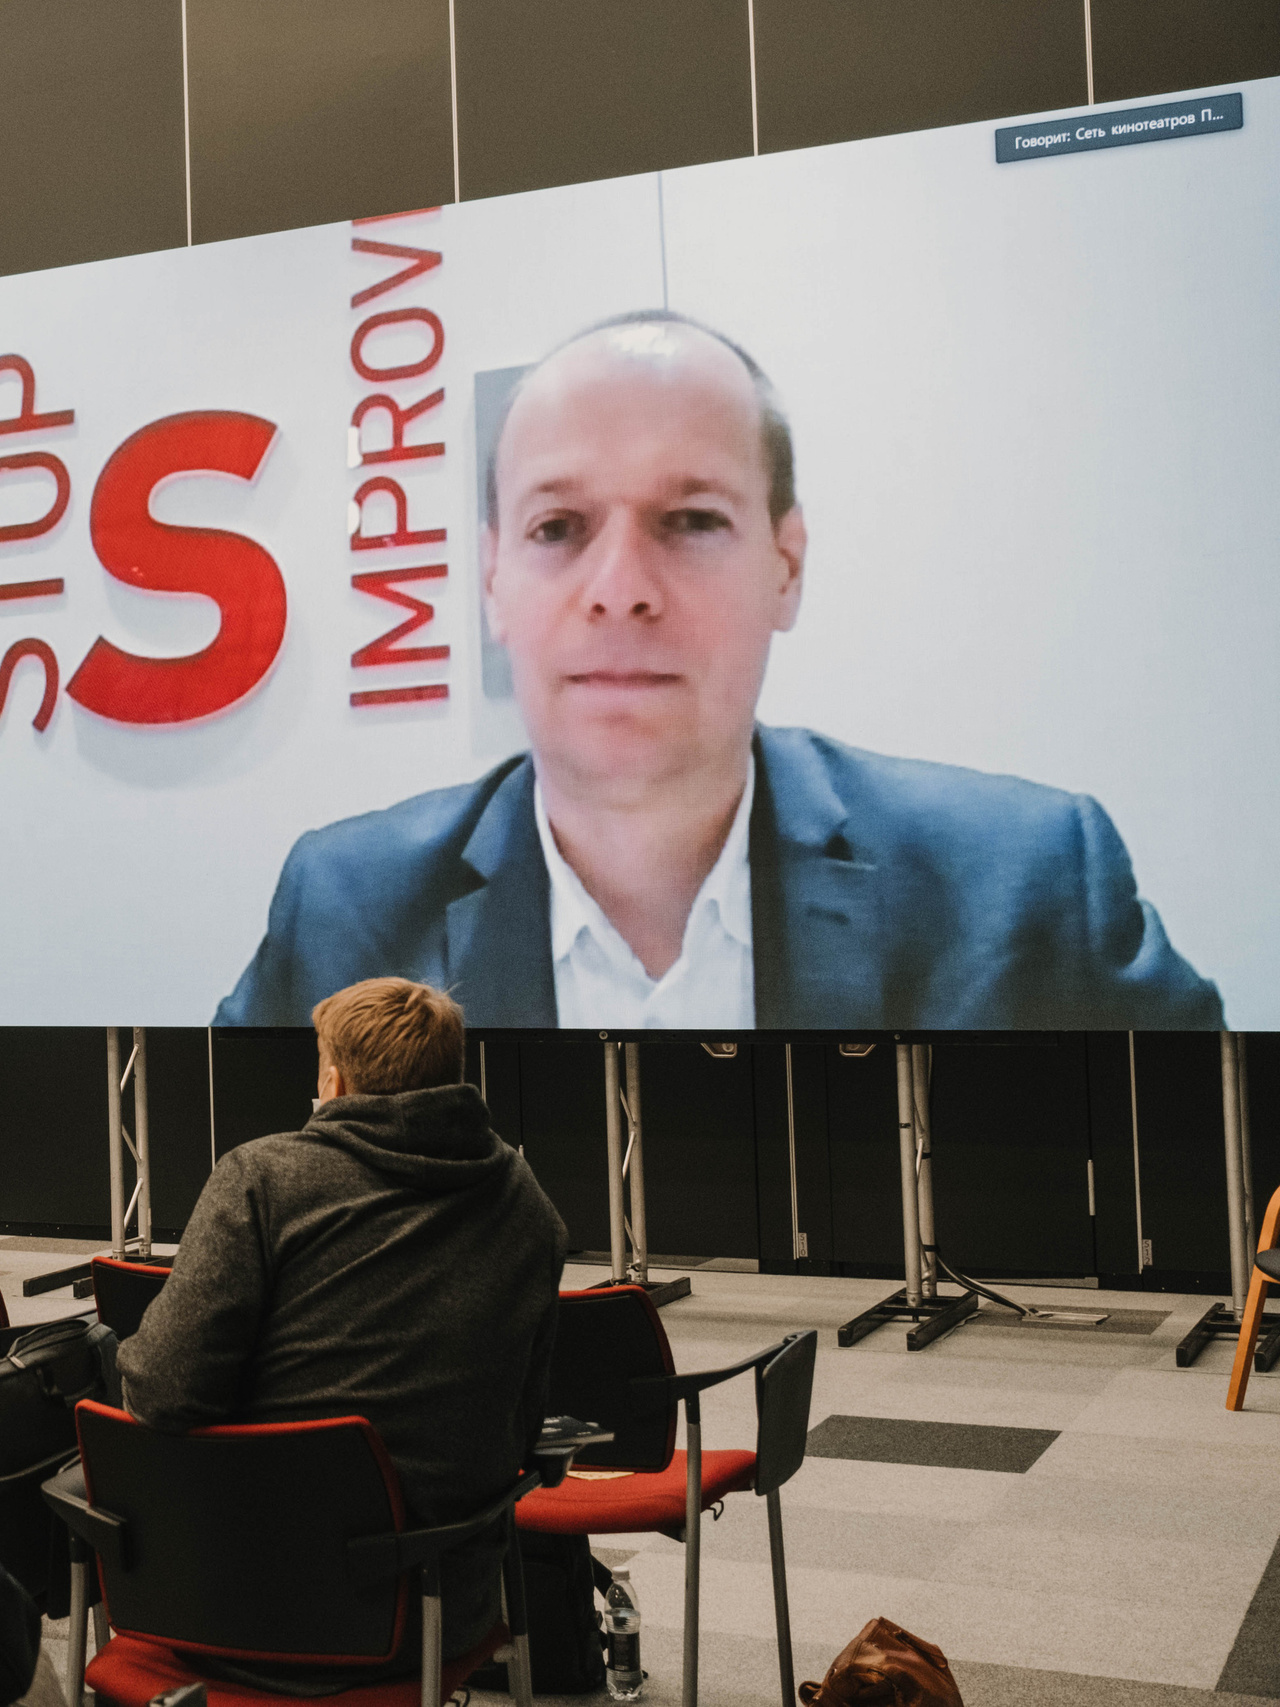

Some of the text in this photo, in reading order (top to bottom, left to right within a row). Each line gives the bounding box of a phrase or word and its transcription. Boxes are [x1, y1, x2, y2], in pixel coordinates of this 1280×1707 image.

[1015, 131, 1071, 150] Говорит:
[1076, 127, 1106, 140] Сеть
[1111, 113, 1195, 136] кинотеатров
[65, 409, 287, 724] S
[350, 206, 451, 707] IMPROV
